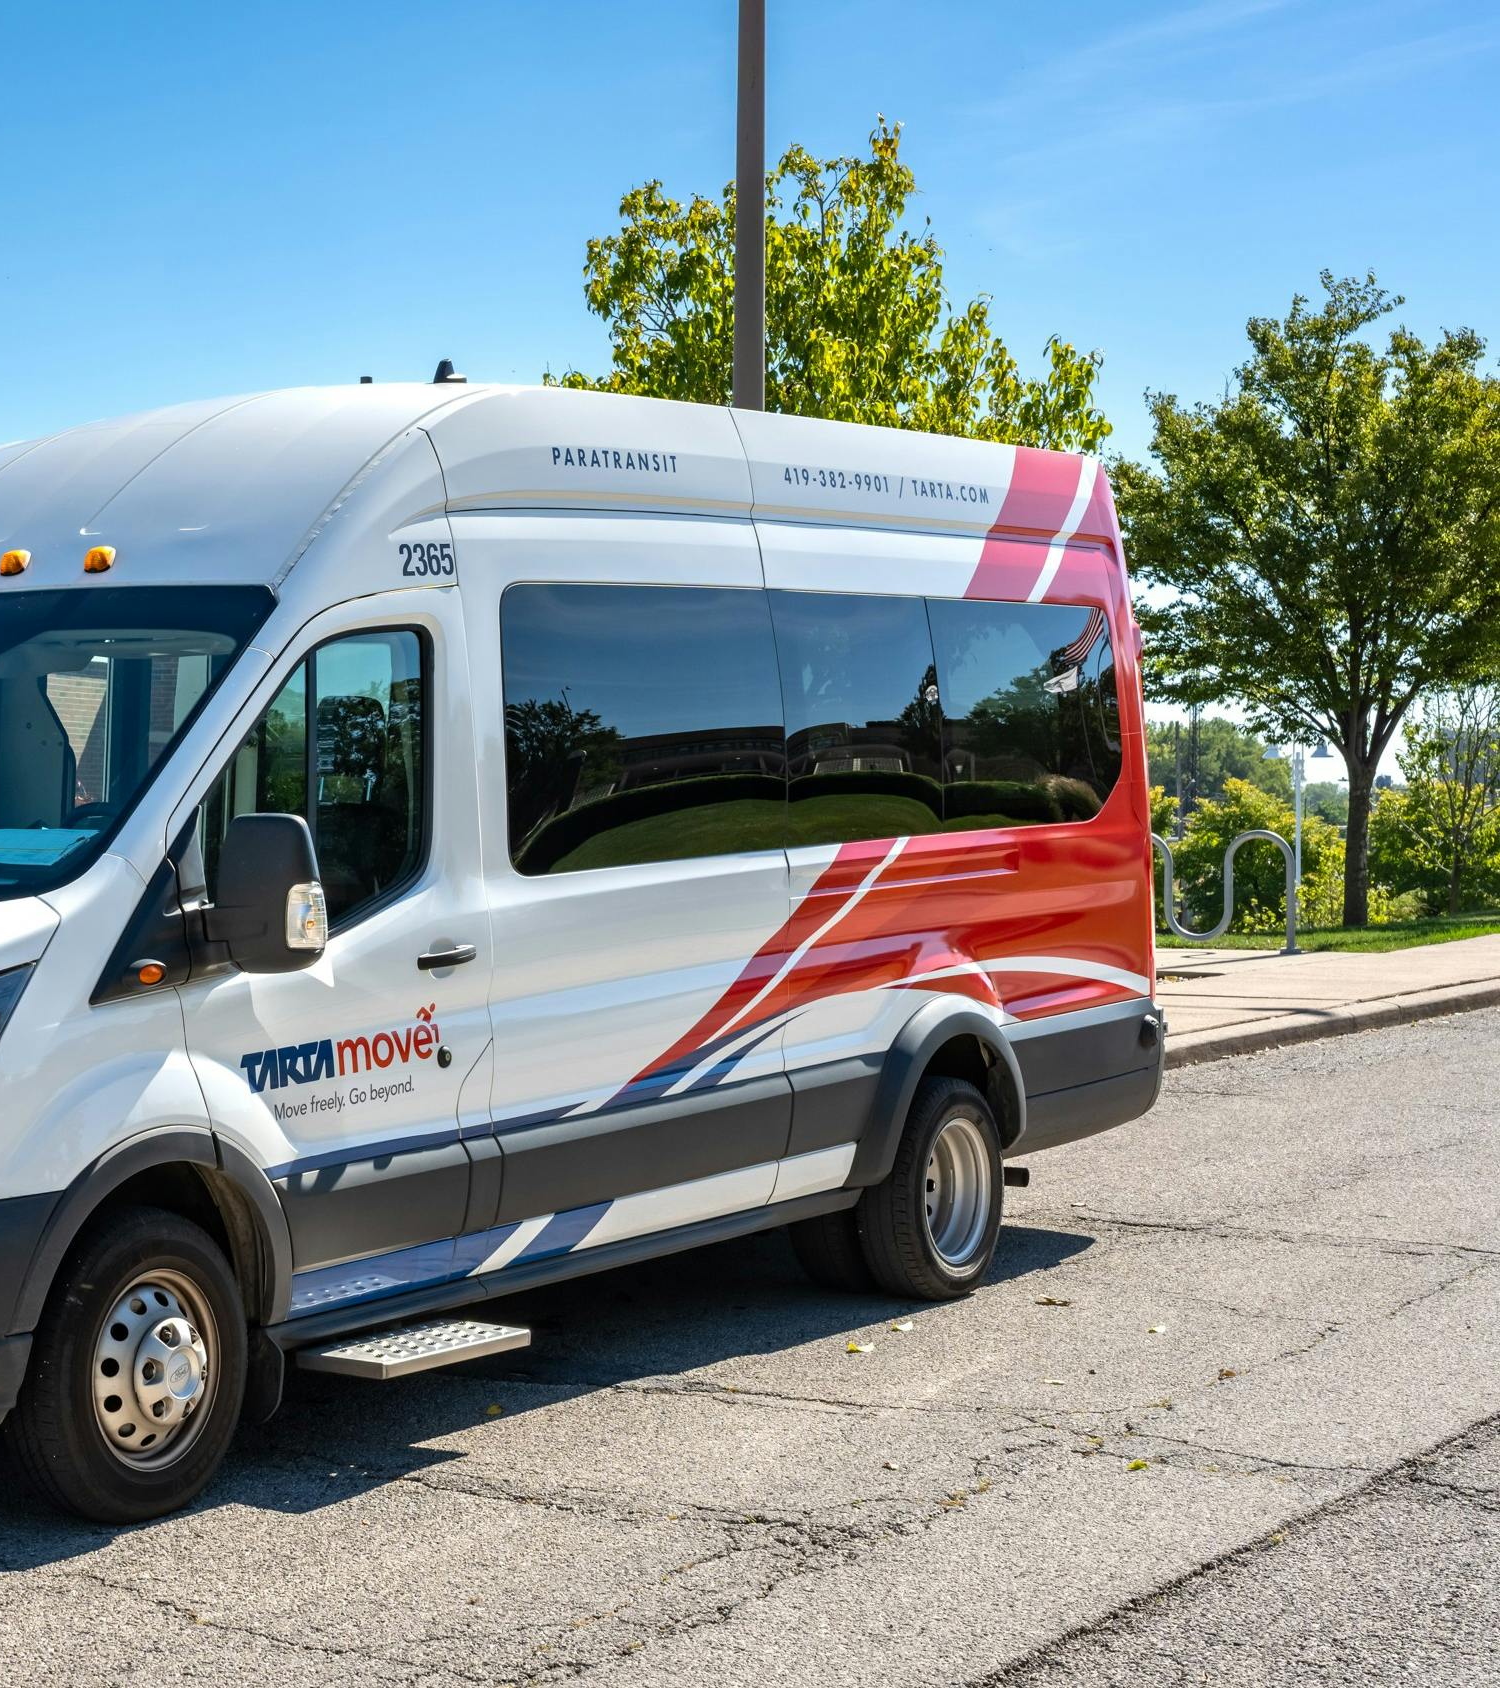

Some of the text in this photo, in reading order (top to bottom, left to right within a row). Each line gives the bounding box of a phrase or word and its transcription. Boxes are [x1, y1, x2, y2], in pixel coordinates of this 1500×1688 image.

[552, 446, 676, 473] PARATRANSIT
[784, 467, 889, 493] 419-382-9901
[911, 479, 990, 504] TARTA.COM
[399, 543, 454, 577] 2365
[274, 1075, 415, 1121] Move freely. Go beyond.
